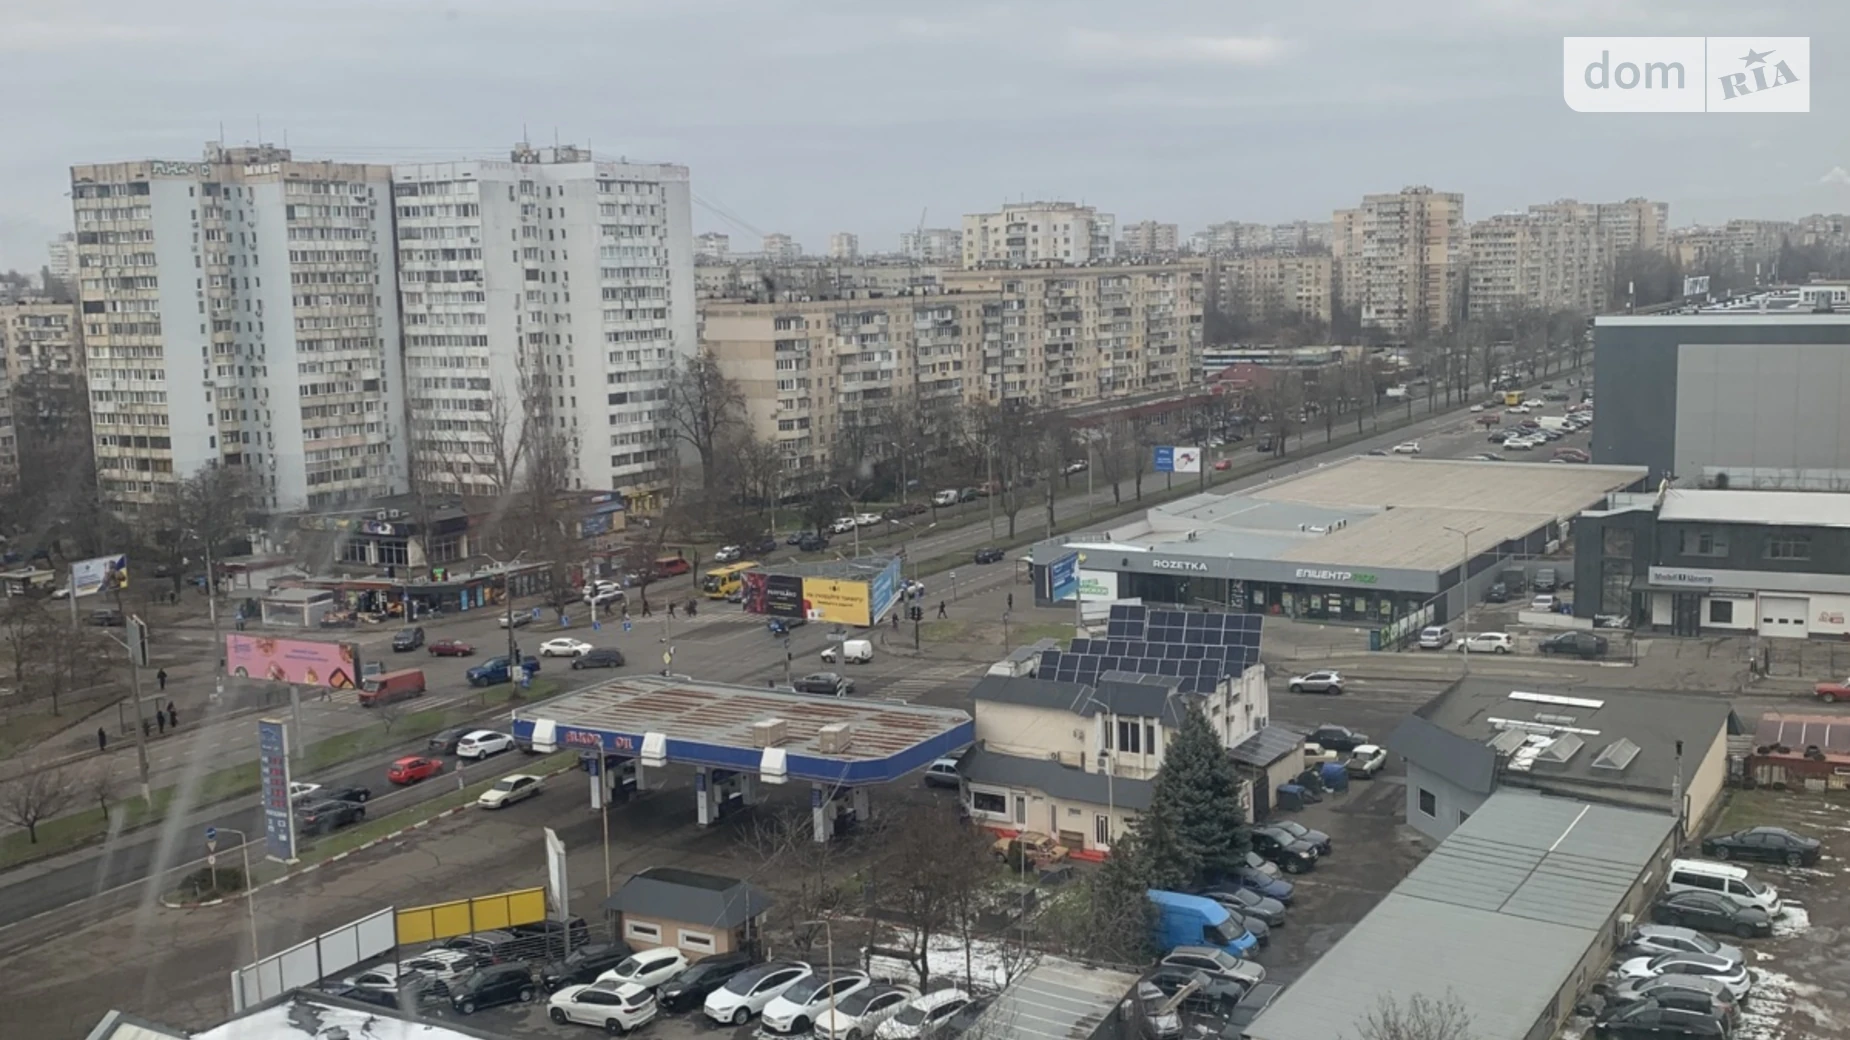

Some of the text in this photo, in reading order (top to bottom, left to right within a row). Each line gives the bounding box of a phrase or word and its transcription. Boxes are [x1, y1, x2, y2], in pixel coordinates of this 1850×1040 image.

[1152, 560, 1208, 572] ROZETKA
[1296, 568, 1352, 581] ЕПІЦЕНТР
[616, 736, 634, 749] OIL
